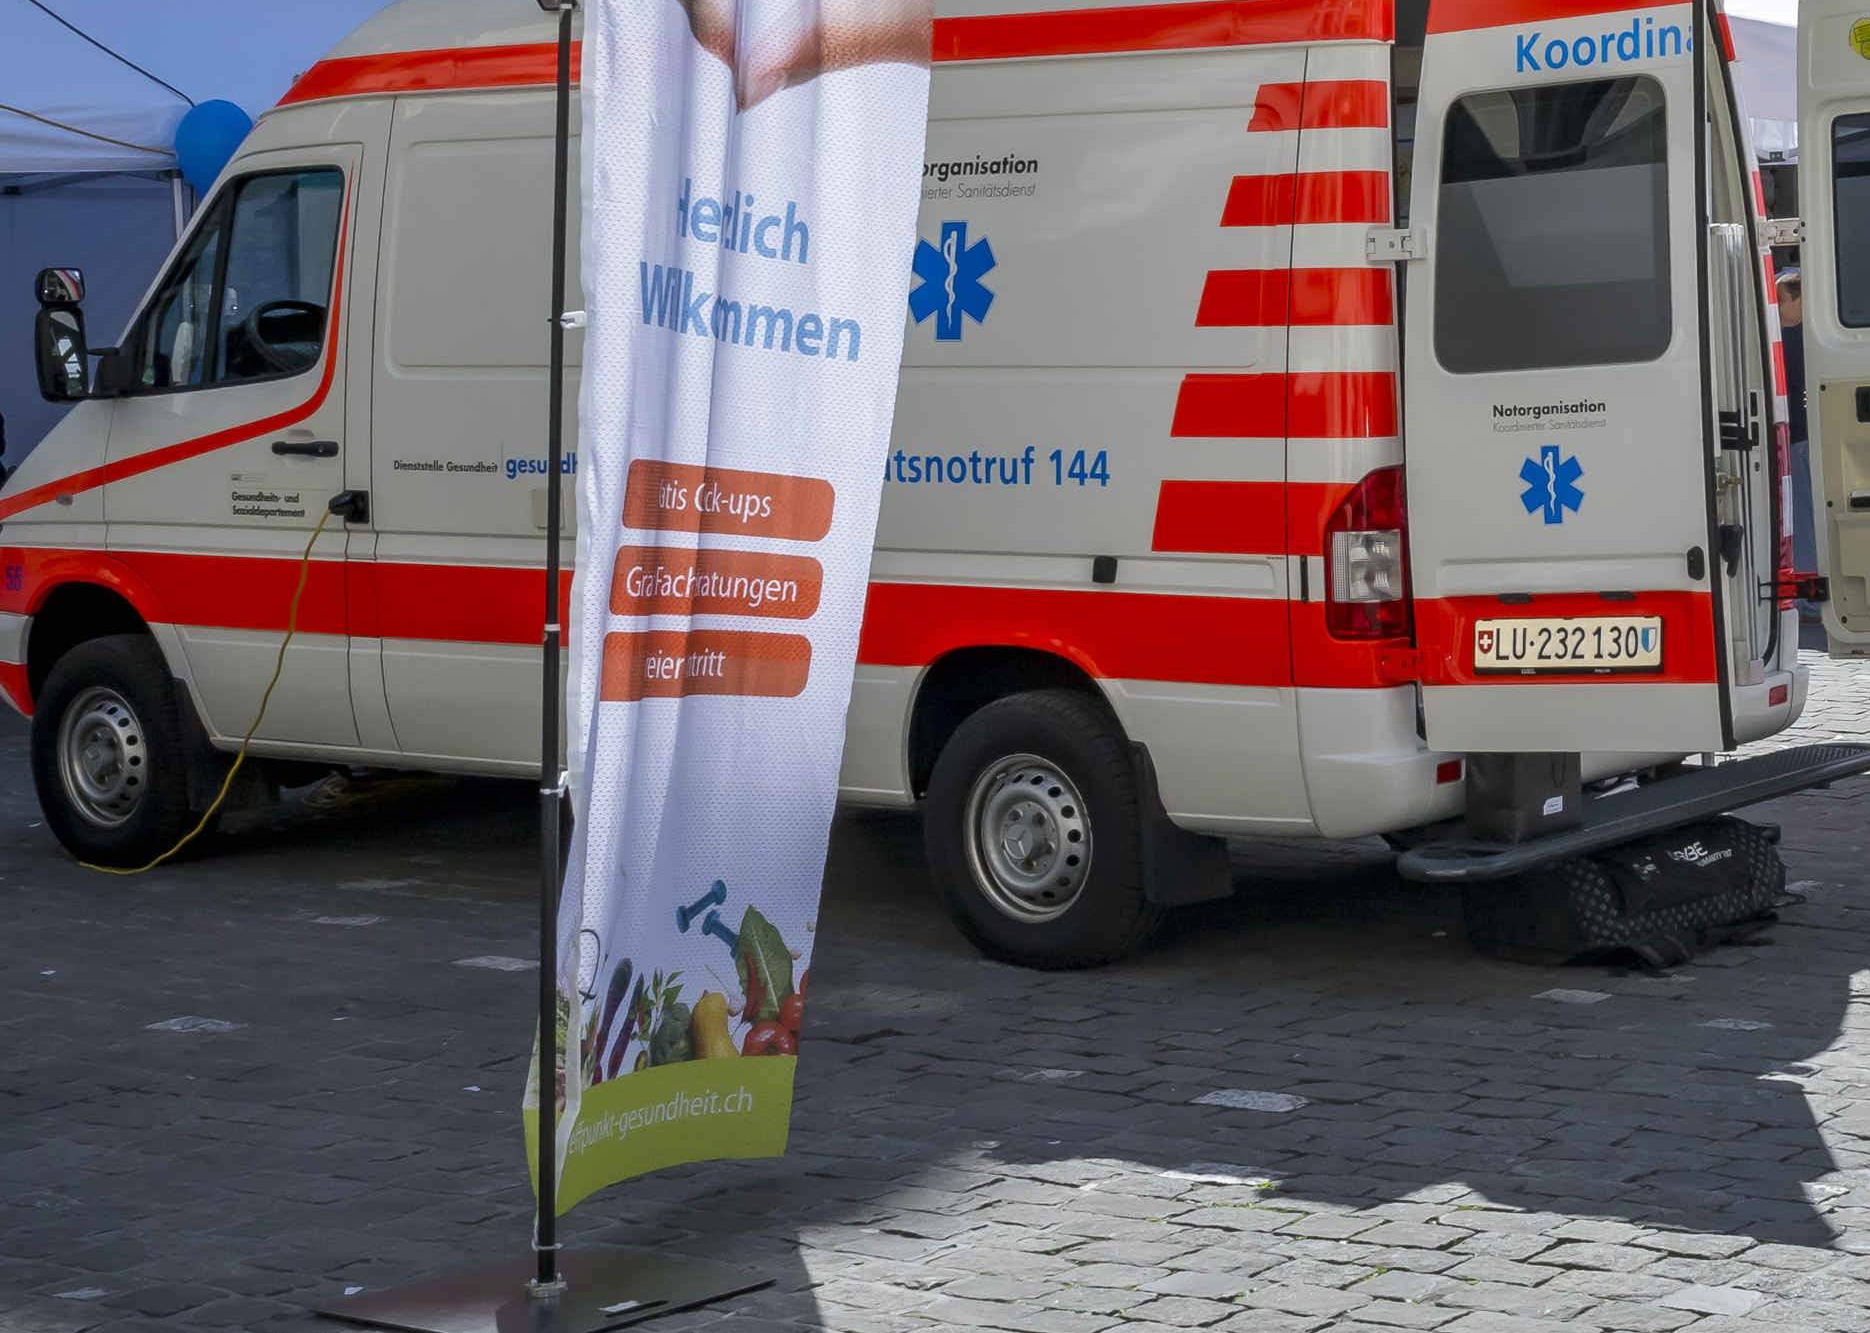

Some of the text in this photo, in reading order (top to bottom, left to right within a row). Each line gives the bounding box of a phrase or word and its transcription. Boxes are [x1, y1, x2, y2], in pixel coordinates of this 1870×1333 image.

[922, 153, 1038, 182] organisation
[957, 180, 1035, 199] Sanitätsdienst
[1493, 399, 1606, 419] Notorganisation
[393, 459, 498, 473] Dienststelle Gesundheit
[506, 452, 577, 479] gesudh
[1049, 449, 1110, 487] 144
[231, 491, 299, 503] Gesundheits- und
[232, 505, 305, 518] Sozialdepartement
[568, 1085, 753, 1156] effpunkt-gesundheit.ch
